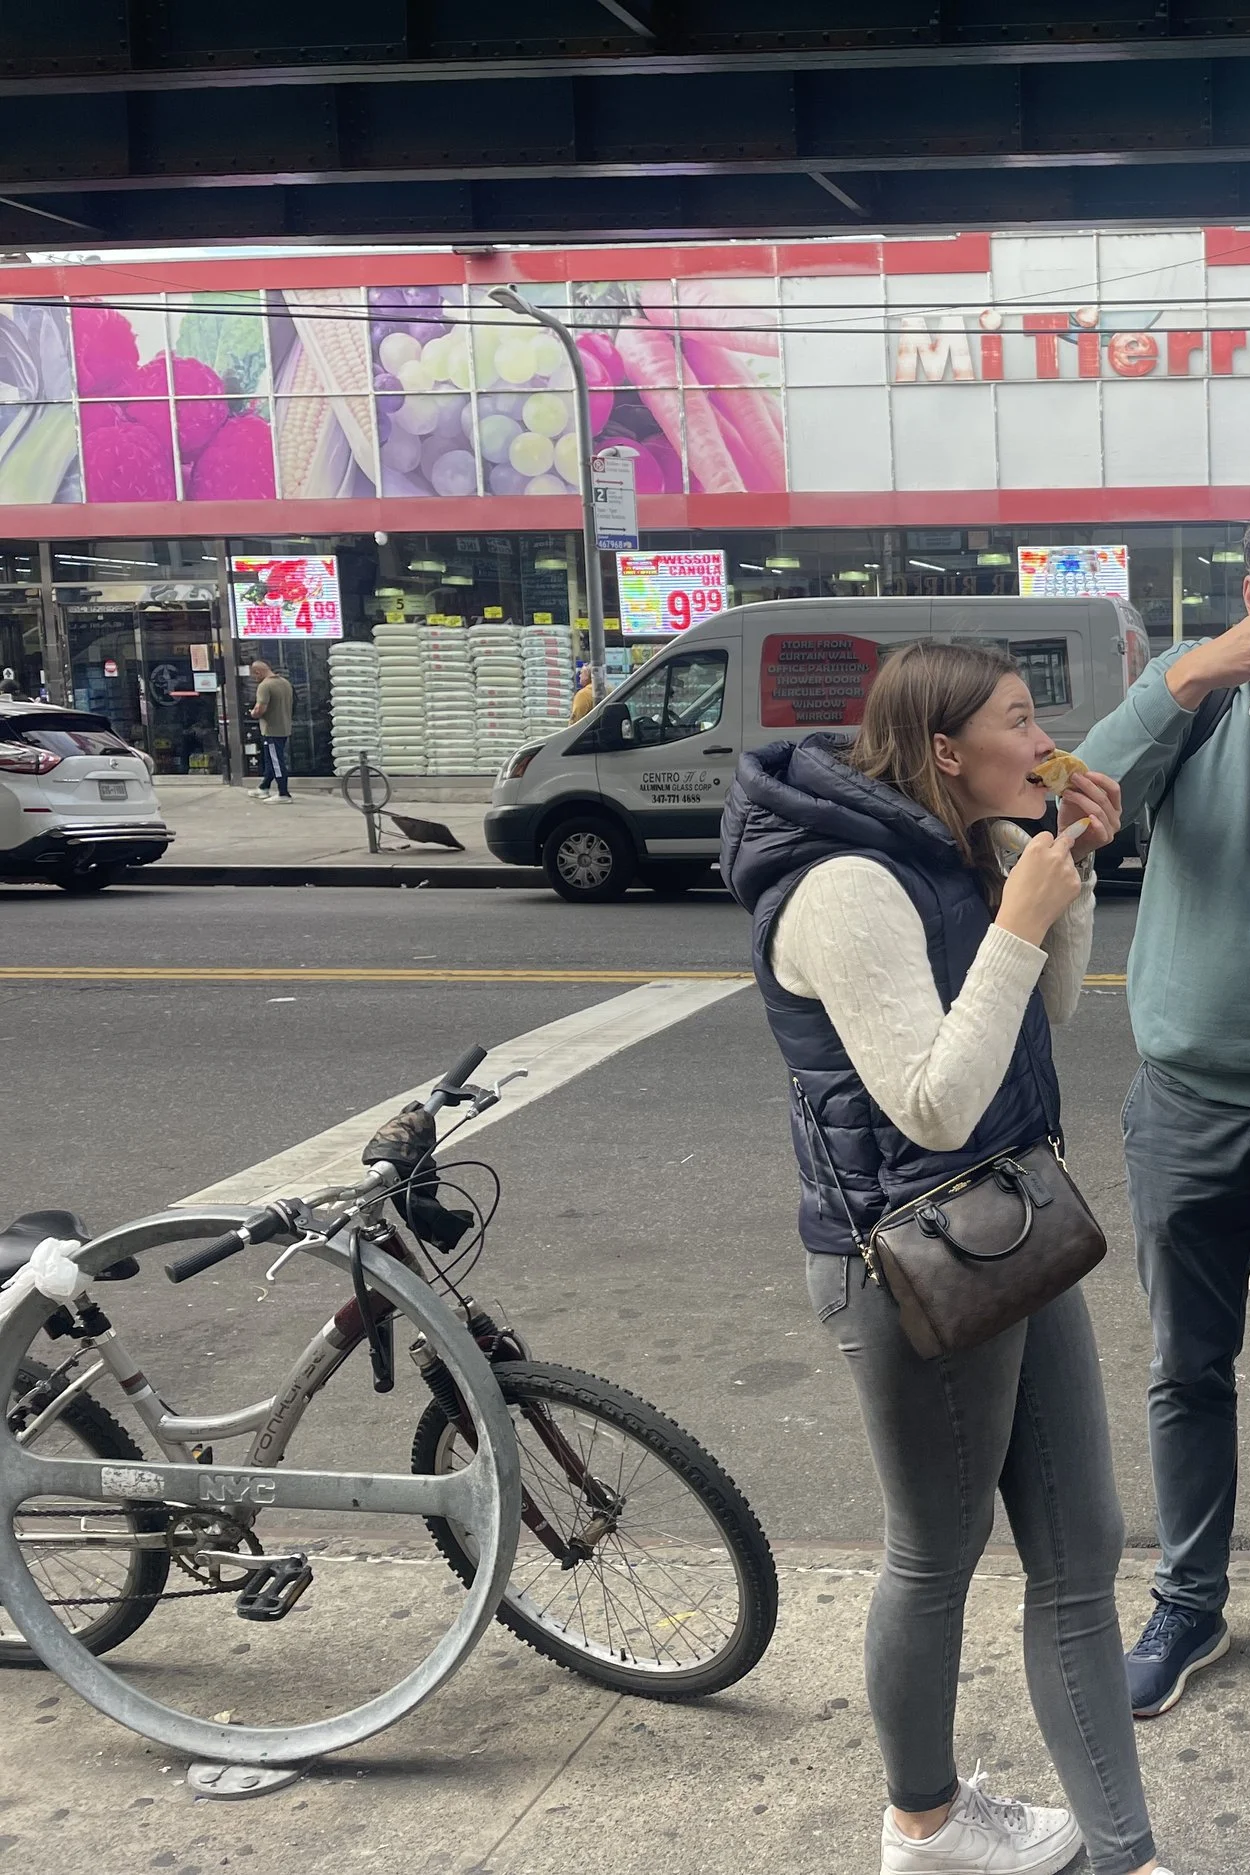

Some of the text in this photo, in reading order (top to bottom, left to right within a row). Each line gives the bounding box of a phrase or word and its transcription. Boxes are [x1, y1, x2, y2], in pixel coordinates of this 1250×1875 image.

[895, 308, 1005, 383] Mi
[597, 489, 605, 502] 2
[669, 565, 721, 576] CANOLA
[782, 639, 853, 649] STORE FRONT
[779, 651, 858, 661] CURTAIN WALL
[767, 663, 870, 673] OFFICE PARTITIONS
[824, 675, 862, 684] DOORS
[792, 700, 846, 709] WINDOWS
[796, 711, 844, 721] MIRRORS
[642, 772, 680, 783] CENTRO
[694, 783, 712, 791] CORP
[199, 1473, 276, 1504] NYC
